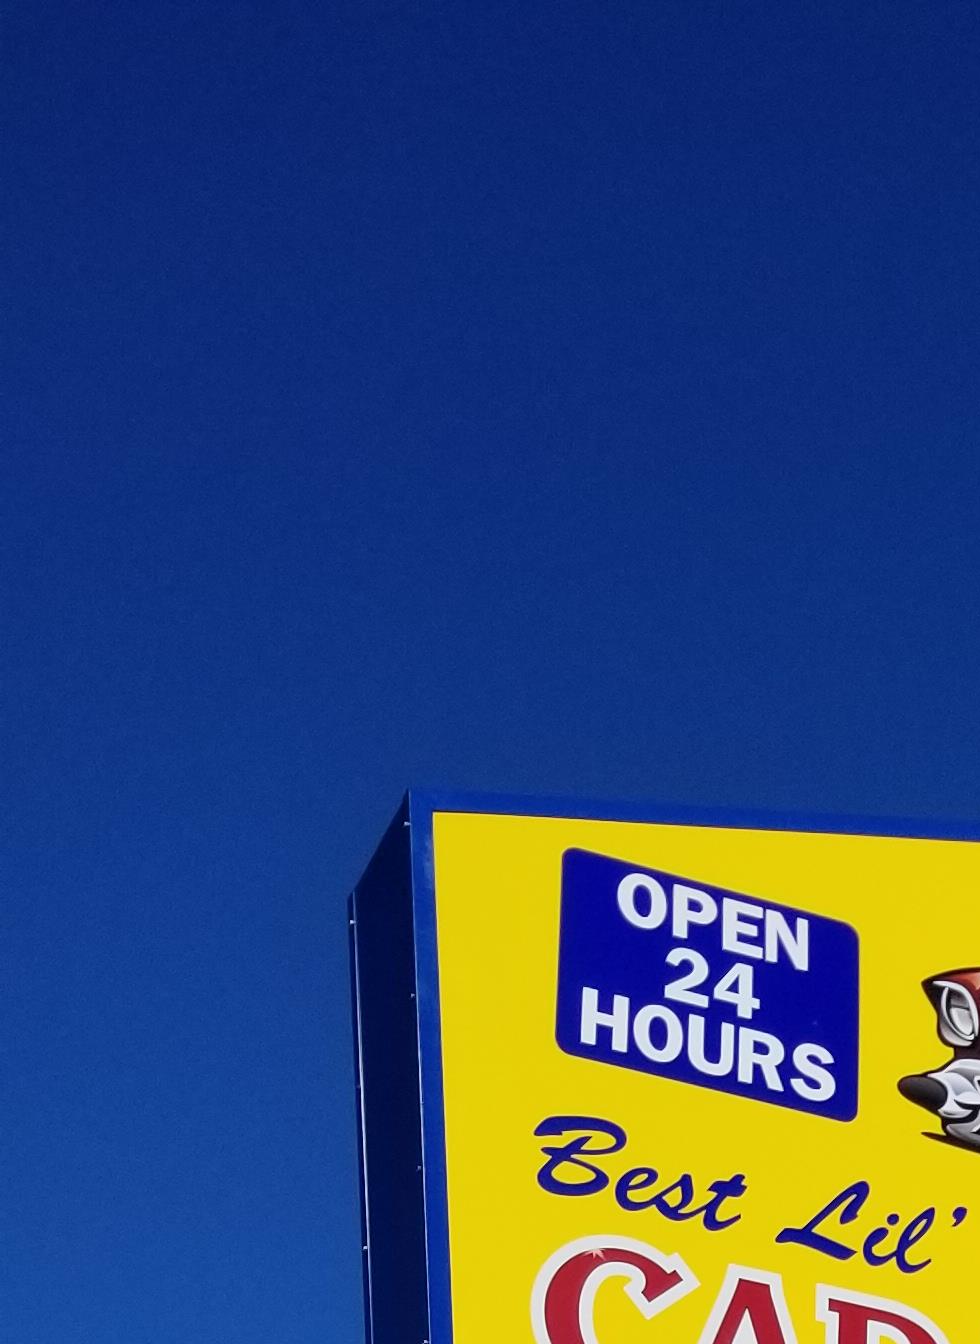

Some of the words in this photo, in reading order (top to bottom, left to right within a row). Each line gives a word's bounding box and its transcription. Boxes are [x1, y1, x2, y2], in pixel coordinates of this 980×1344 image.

[616, 872, 809, 972] OPEN
[663, 946, 761, 1020] 24
[578, 985, 836, 1102] HOURS
[533, 1115, 748, 1231] Best
[775, 1180, 968, 1274] Lil'
